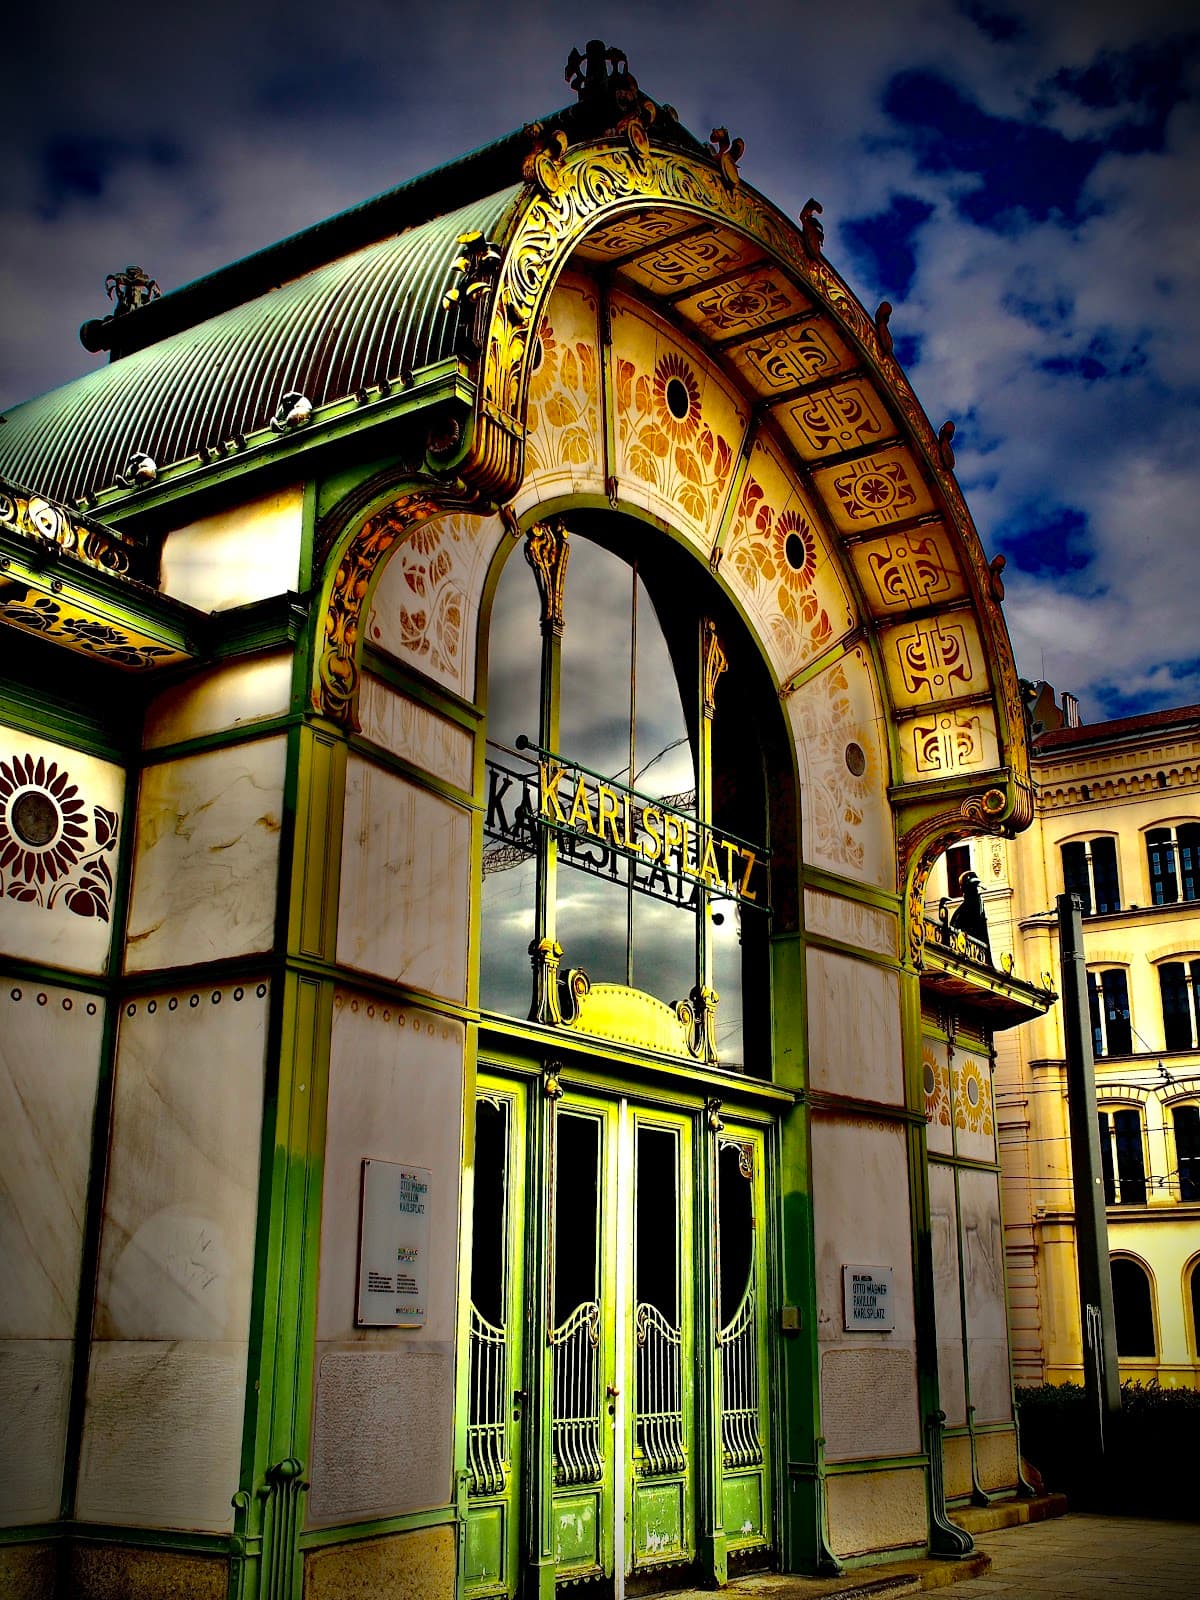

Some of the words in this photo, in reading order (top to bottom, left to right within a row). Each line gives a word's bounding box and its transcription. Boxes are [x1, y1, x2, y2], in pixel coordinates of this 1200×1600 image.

[538, 760, 756, 900] KARLSPLATZ
[852, 1283, 866, 1294] OTTO
[853, 1295, 877, 1307] PAVILLON
[853, 1308, 885, 1319] KARLSPLATZ
